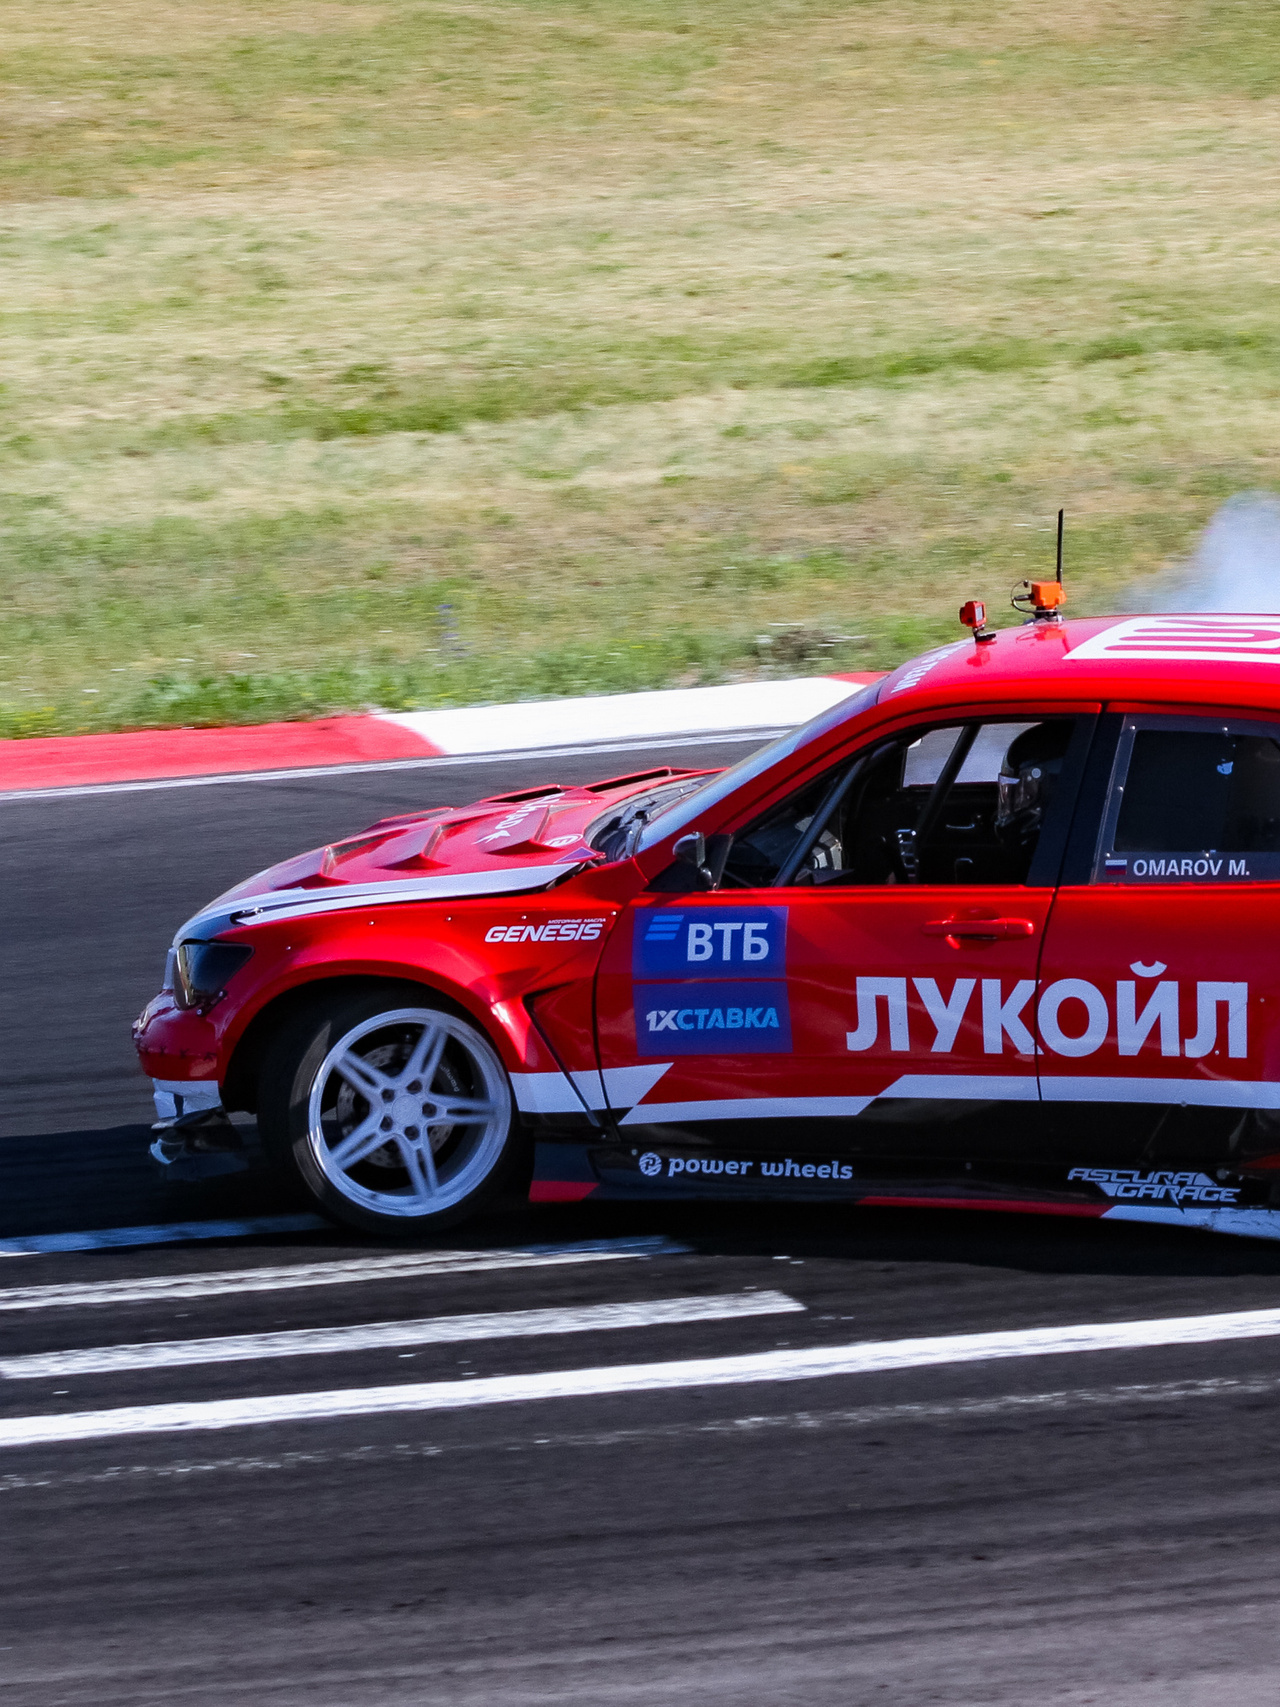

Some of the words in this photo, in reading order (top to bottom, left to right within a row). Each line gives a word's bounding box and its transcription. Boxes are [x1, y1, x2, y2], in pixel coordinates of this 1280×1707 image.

[1133, 859, 1224, 876] OMAROV
[1228, 859, 1250, 876] M.
[484, 923, 603, 943] GENESIS
[687, 922, 770, 962] ВТБ
[846, 960, 1248, 1059] ЛУКОЙЛ
[668, 1157, 753, 1177] power
[760, 1158, 853, 1179] wheels
[1115, 1183, 1241, 1204] GARAGE
